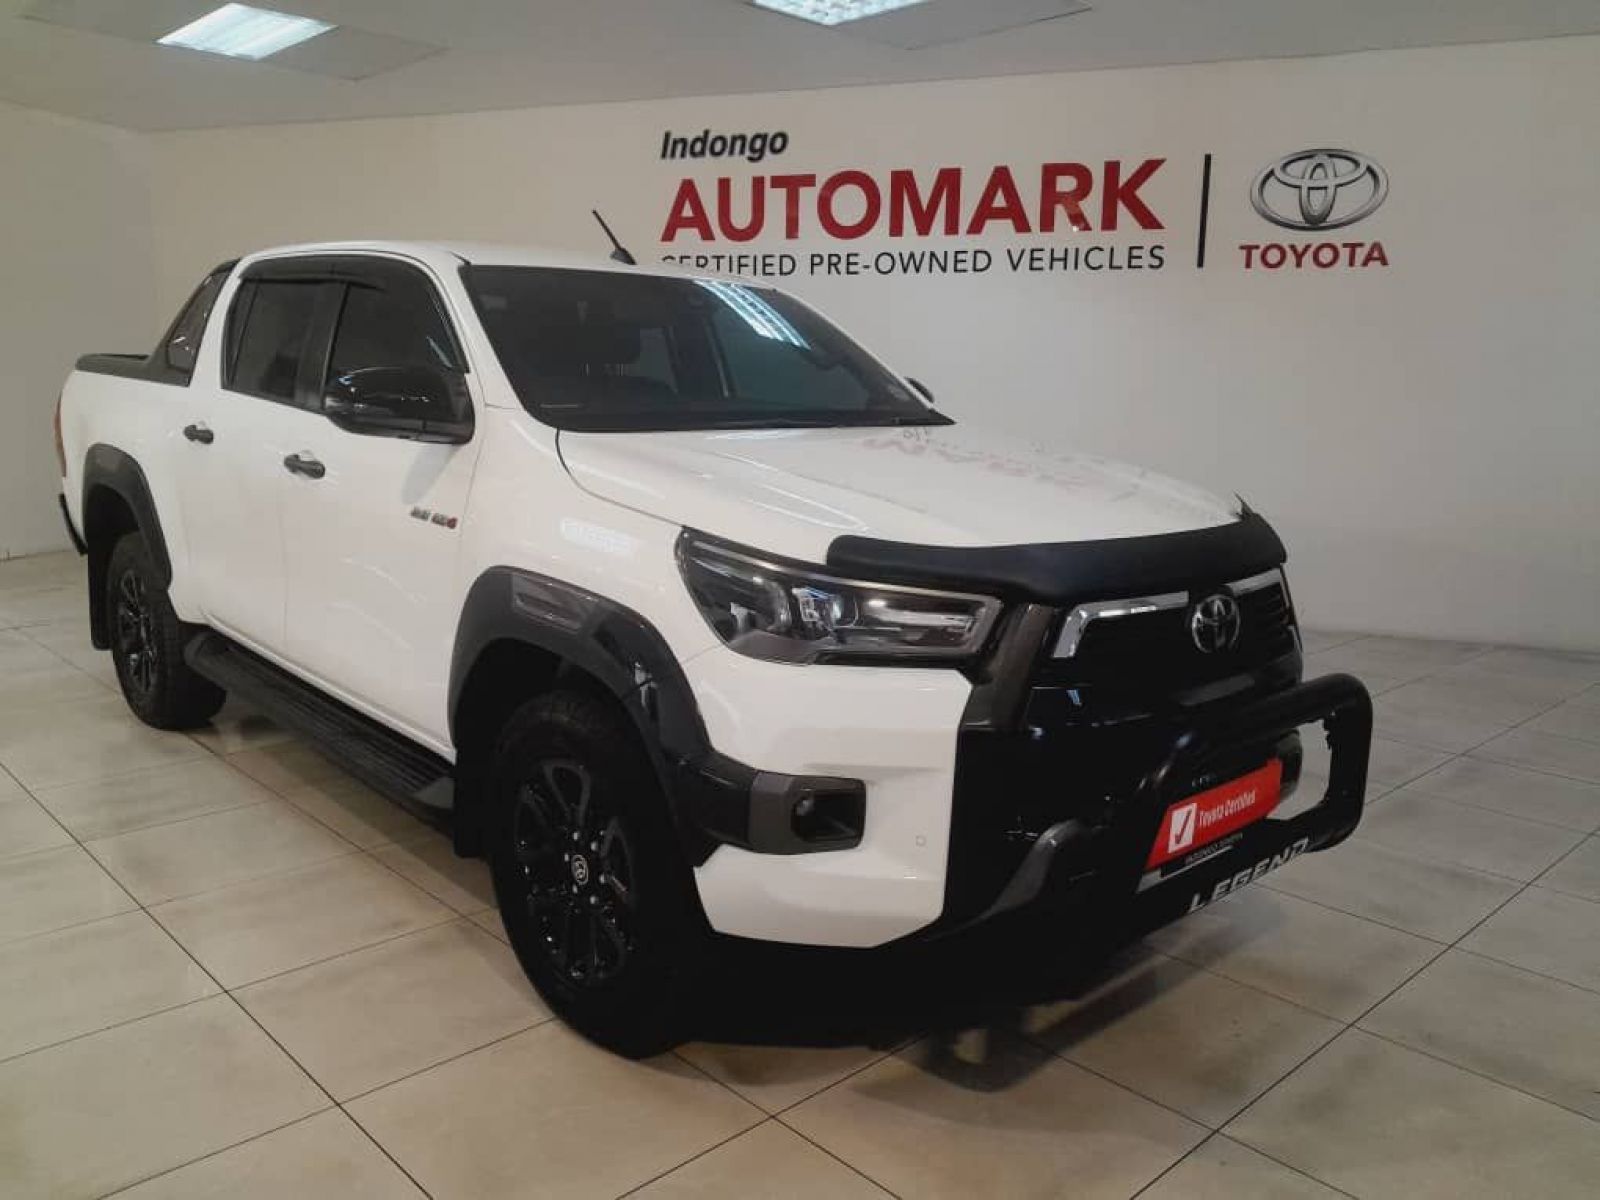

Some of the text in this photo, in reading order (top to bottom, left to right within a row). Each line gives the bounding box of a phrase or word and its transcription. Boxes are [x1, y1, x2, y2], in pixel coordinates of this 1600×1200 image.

[661, 129, 789, 163] Indongo
[661, 158, 1167, 243] AUTOMARK
[810, 249, 993, 277] PRE-OWNED
[1006, 244, 1166, 273] VEHICLES
[1239, 241, 1389, 270] TOYOTA
